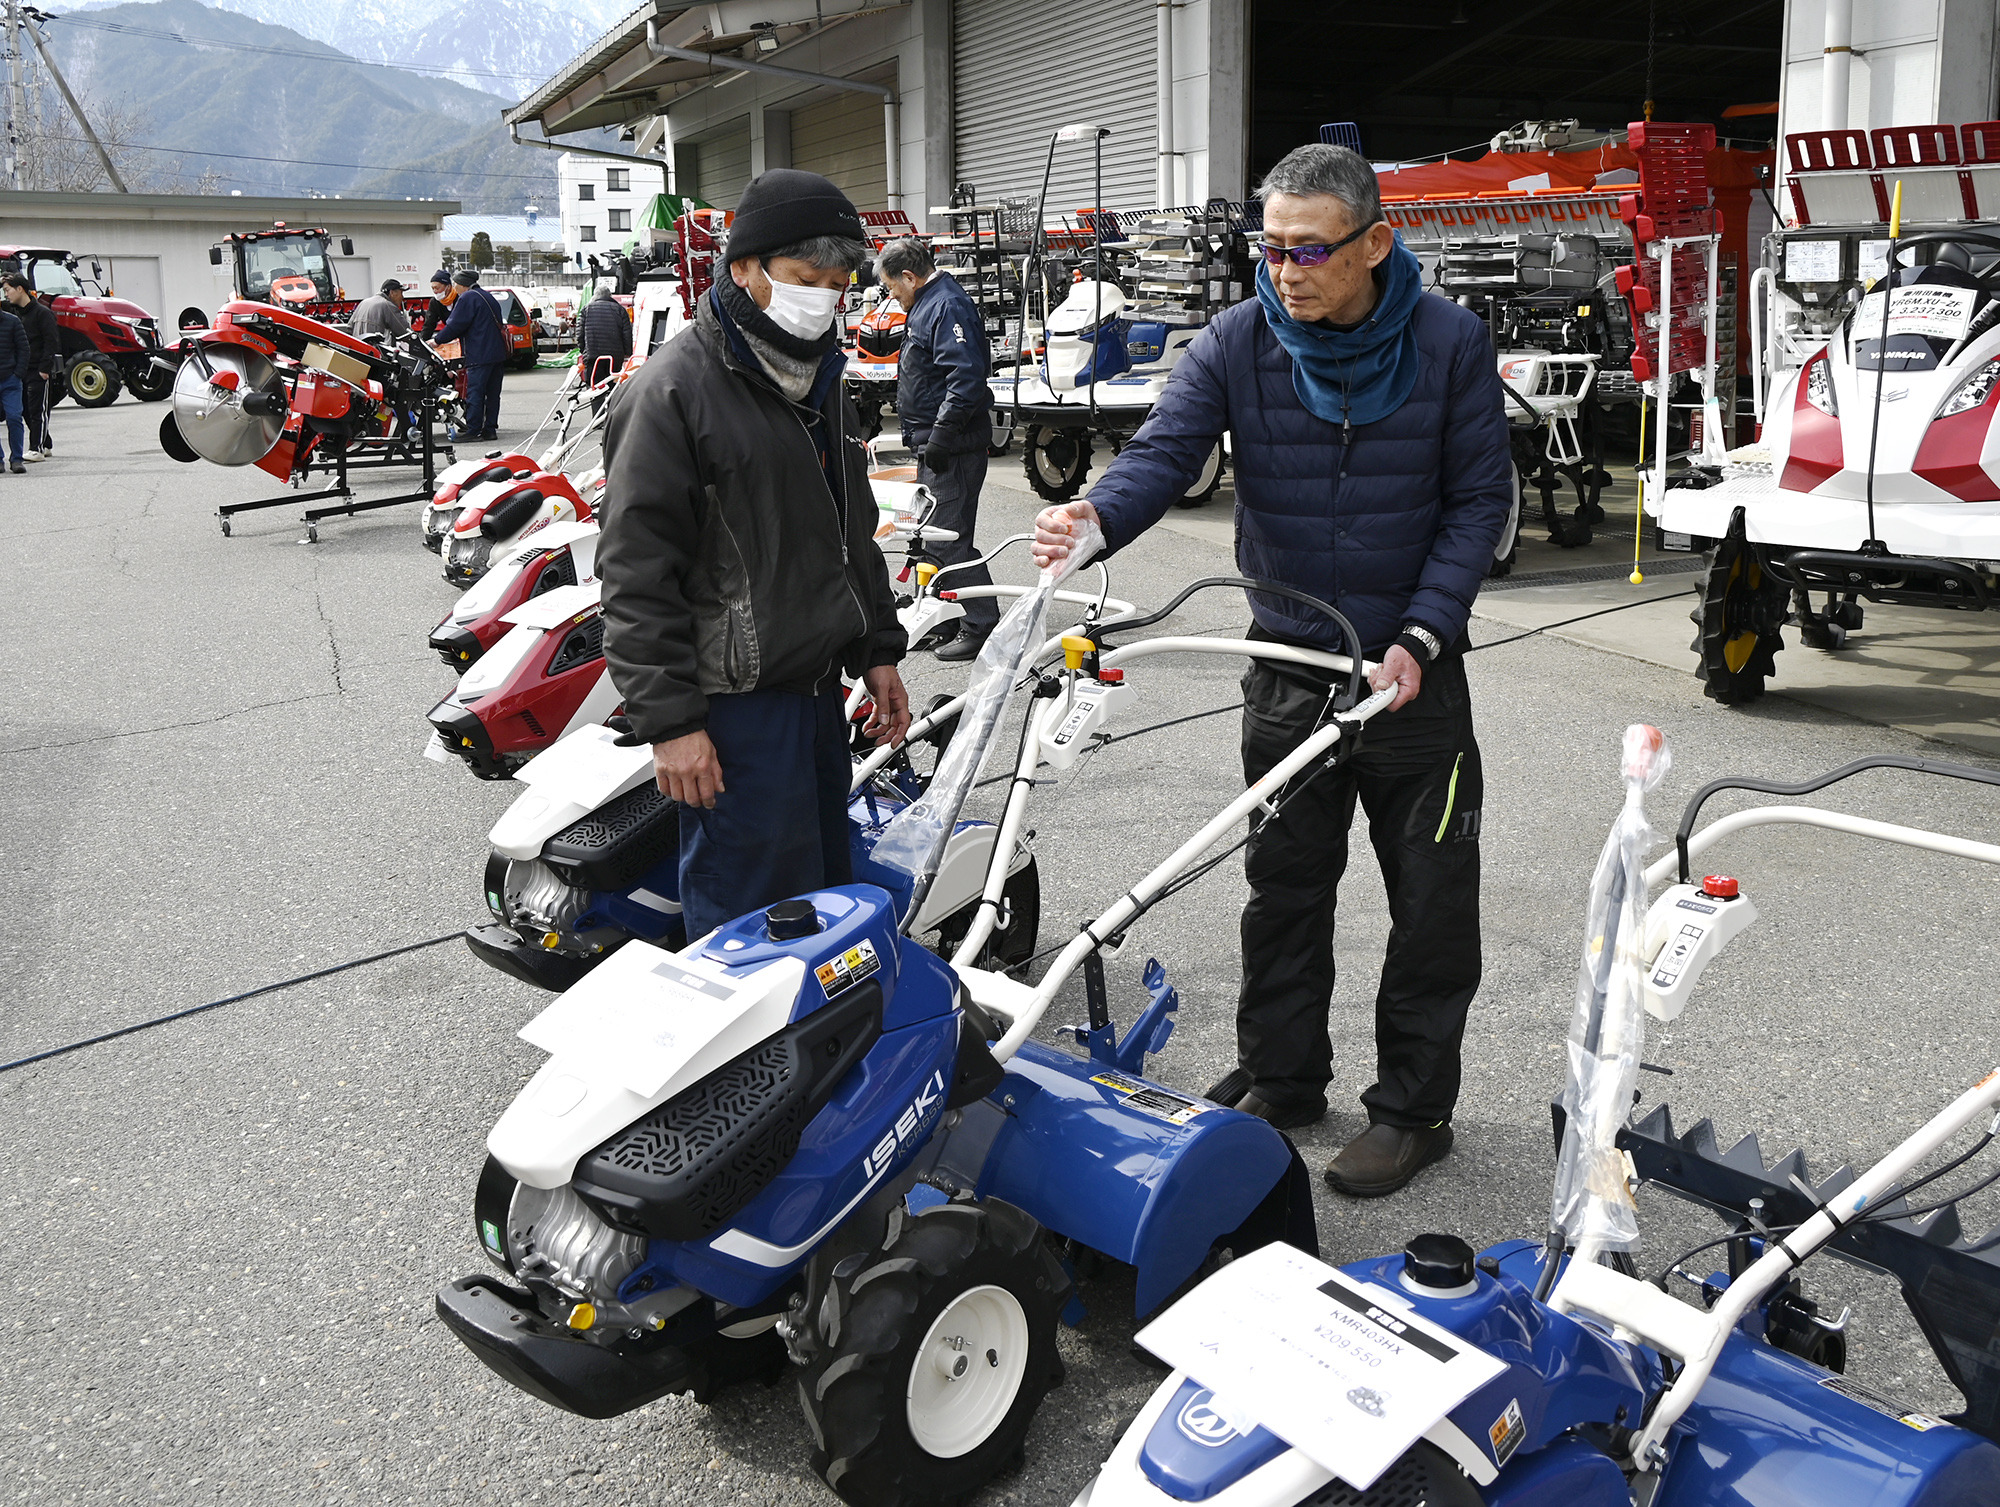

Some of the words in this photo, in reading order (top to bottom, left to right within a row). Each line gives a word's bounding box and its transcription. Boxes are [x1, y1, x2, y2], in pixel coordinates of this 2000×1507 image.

[863, 1069, 944, 1179] ISEKI
[897, 1095, 944, 1158] KCR659
[1330, 1309, 1404, 1355] KMR403HX
